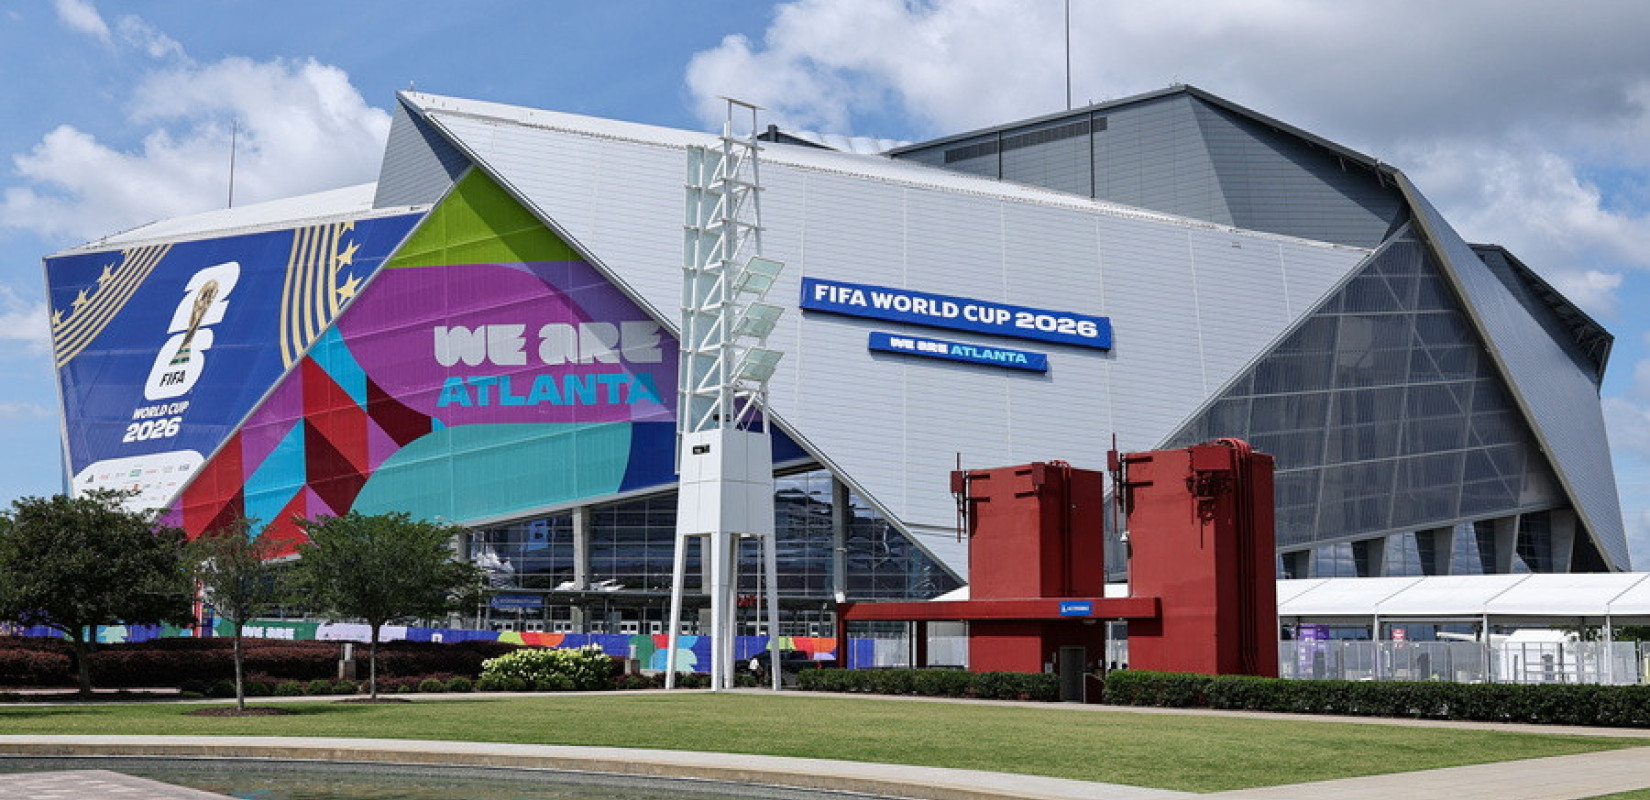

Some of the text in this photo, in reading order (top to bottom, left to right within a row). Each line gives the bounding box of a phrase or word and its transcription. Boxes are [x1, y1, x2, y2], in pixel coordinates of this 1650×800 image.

[815, 284, 1099, 338] FIFA WORLD CUP 2026
[434, 320, 662, 367] WE ARE
[890, 337, 1028, 364] WE ARE ATLANTA
[160, 370, 185, 387] FIFA
[436, 373, 664, 407] ATLANTA
[133, 401, 189, 419] WORLD CUP
[123, 417, 182, 442] 2026
